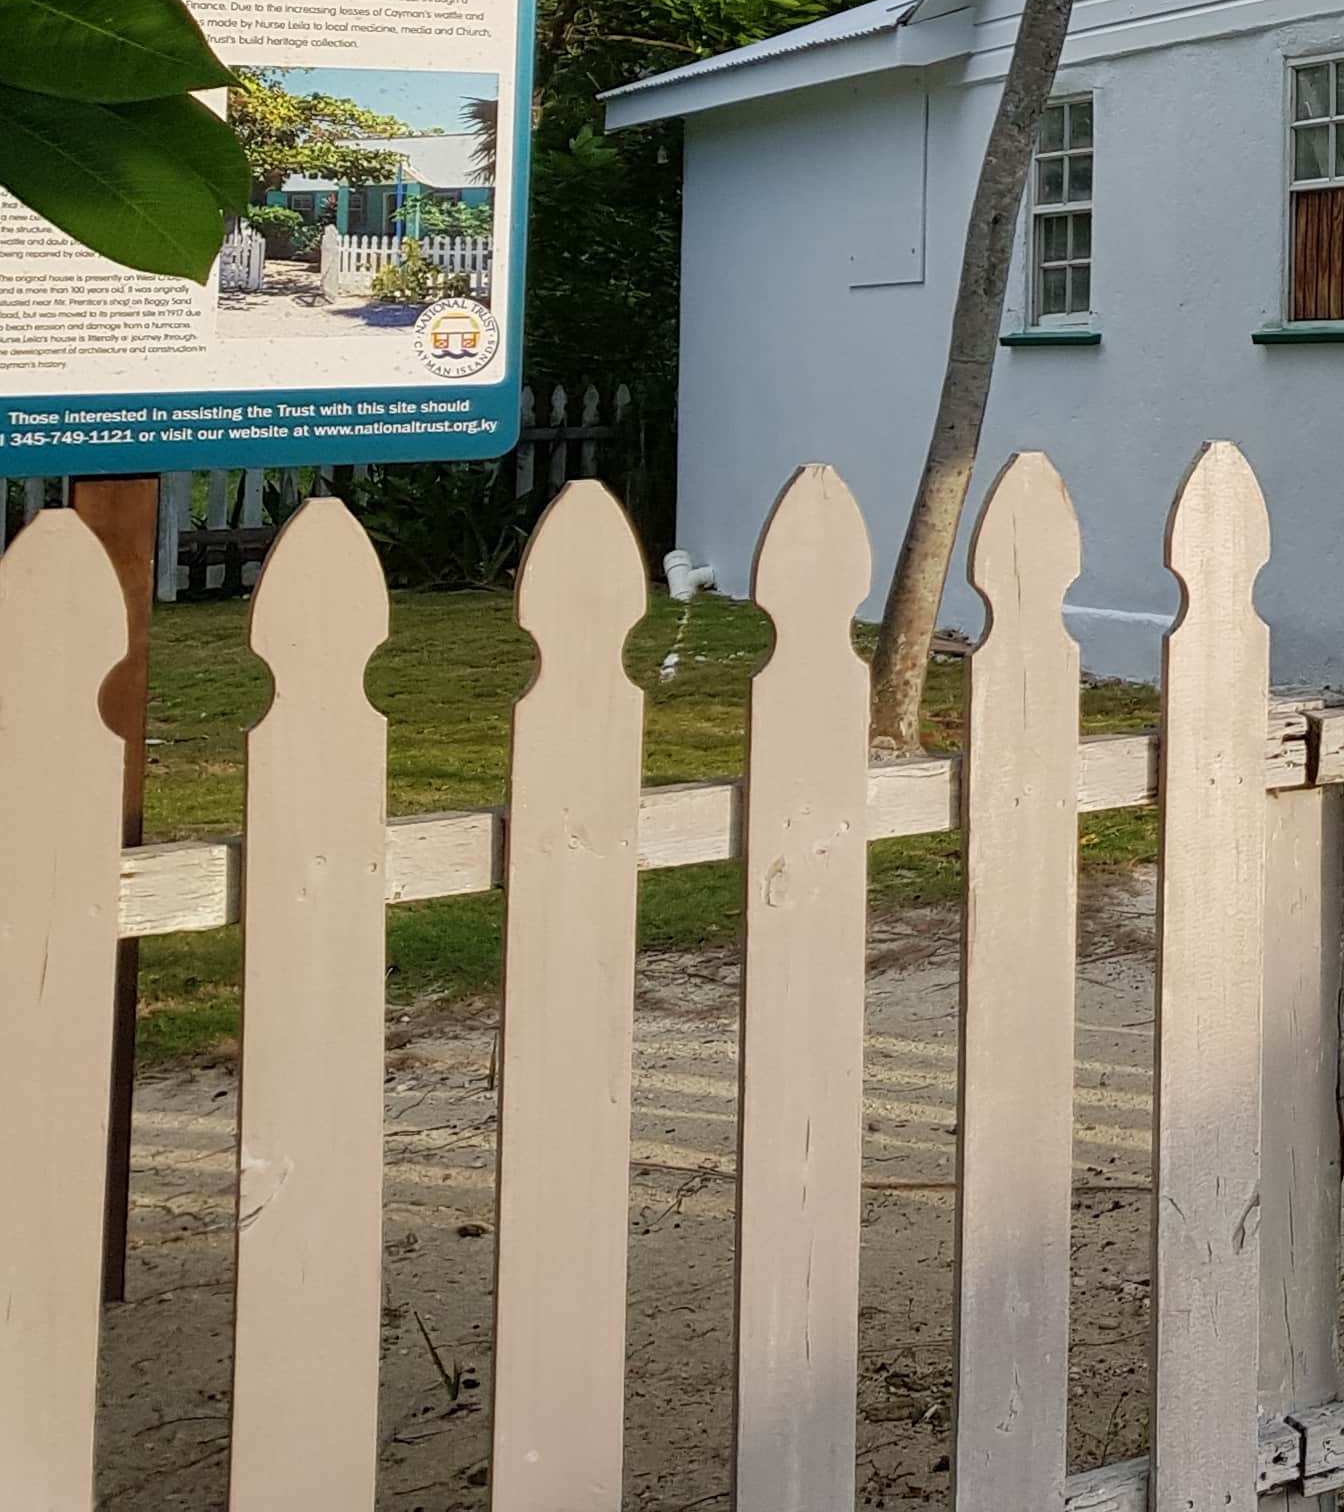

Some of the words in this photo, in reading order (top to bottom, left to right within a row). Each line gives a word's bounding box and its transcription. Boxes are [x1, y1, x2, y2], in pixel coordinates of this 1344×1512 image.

[230, 2, 252, 12] Due
[255, 4, 264, 12] to
[267, 4, 282, 12] the
[285, 5, 336, 16] increasing
[339, 6, 370, 16] losses
[372, 8, 383, 16] of
[434, 11, 463, 20] wattle
[465, 12, 484, 21] and
[208, 18, 237, 27] made
[240, 19, 252, 30] by
[255, 20, 286, 29] Nurse
[288, 21, 310, 30] Leila
[313, 22, 323, 30] to
[325, 22, 348, 32] local
[401, 25, 432, 35] media
[435, 27, 453, 36] and
[239, 36, 264, 45] build
[267, 37, 308, 48] heritage
[15, 274, 47, 284] original
[415, 299, 468, 335] NATIONAL
[471, 303, 496, 333] TRUST
[414, 341, 452, 375] CAYMAN
[456, 340, 496, 375] ISLANDS
[8, 411, 59, 425] Those
[64, 408, 147, 423] interested
[152, 408, 167, 421] in
[172, 406, 243, 421] assisting
[247, 405, 272, 418] the
[277, 404, 315, 417] Trust
[319, 403, 352, 416] with
[357, 402, 385, 416] this
[388, 401, 417, 414] site
[420, 399, 470, 414] should
[9, 429, 135, 447] 345-749-1121
[138, 430, 156, 442] or
[160, 427, 192, 441] visit
[197, 428, 225, 440] our
[228, 424, 288, 439] website
[293, 425, 309, 437] at
[314, 418, 498, 437] www.nationaltrust.org.ky
